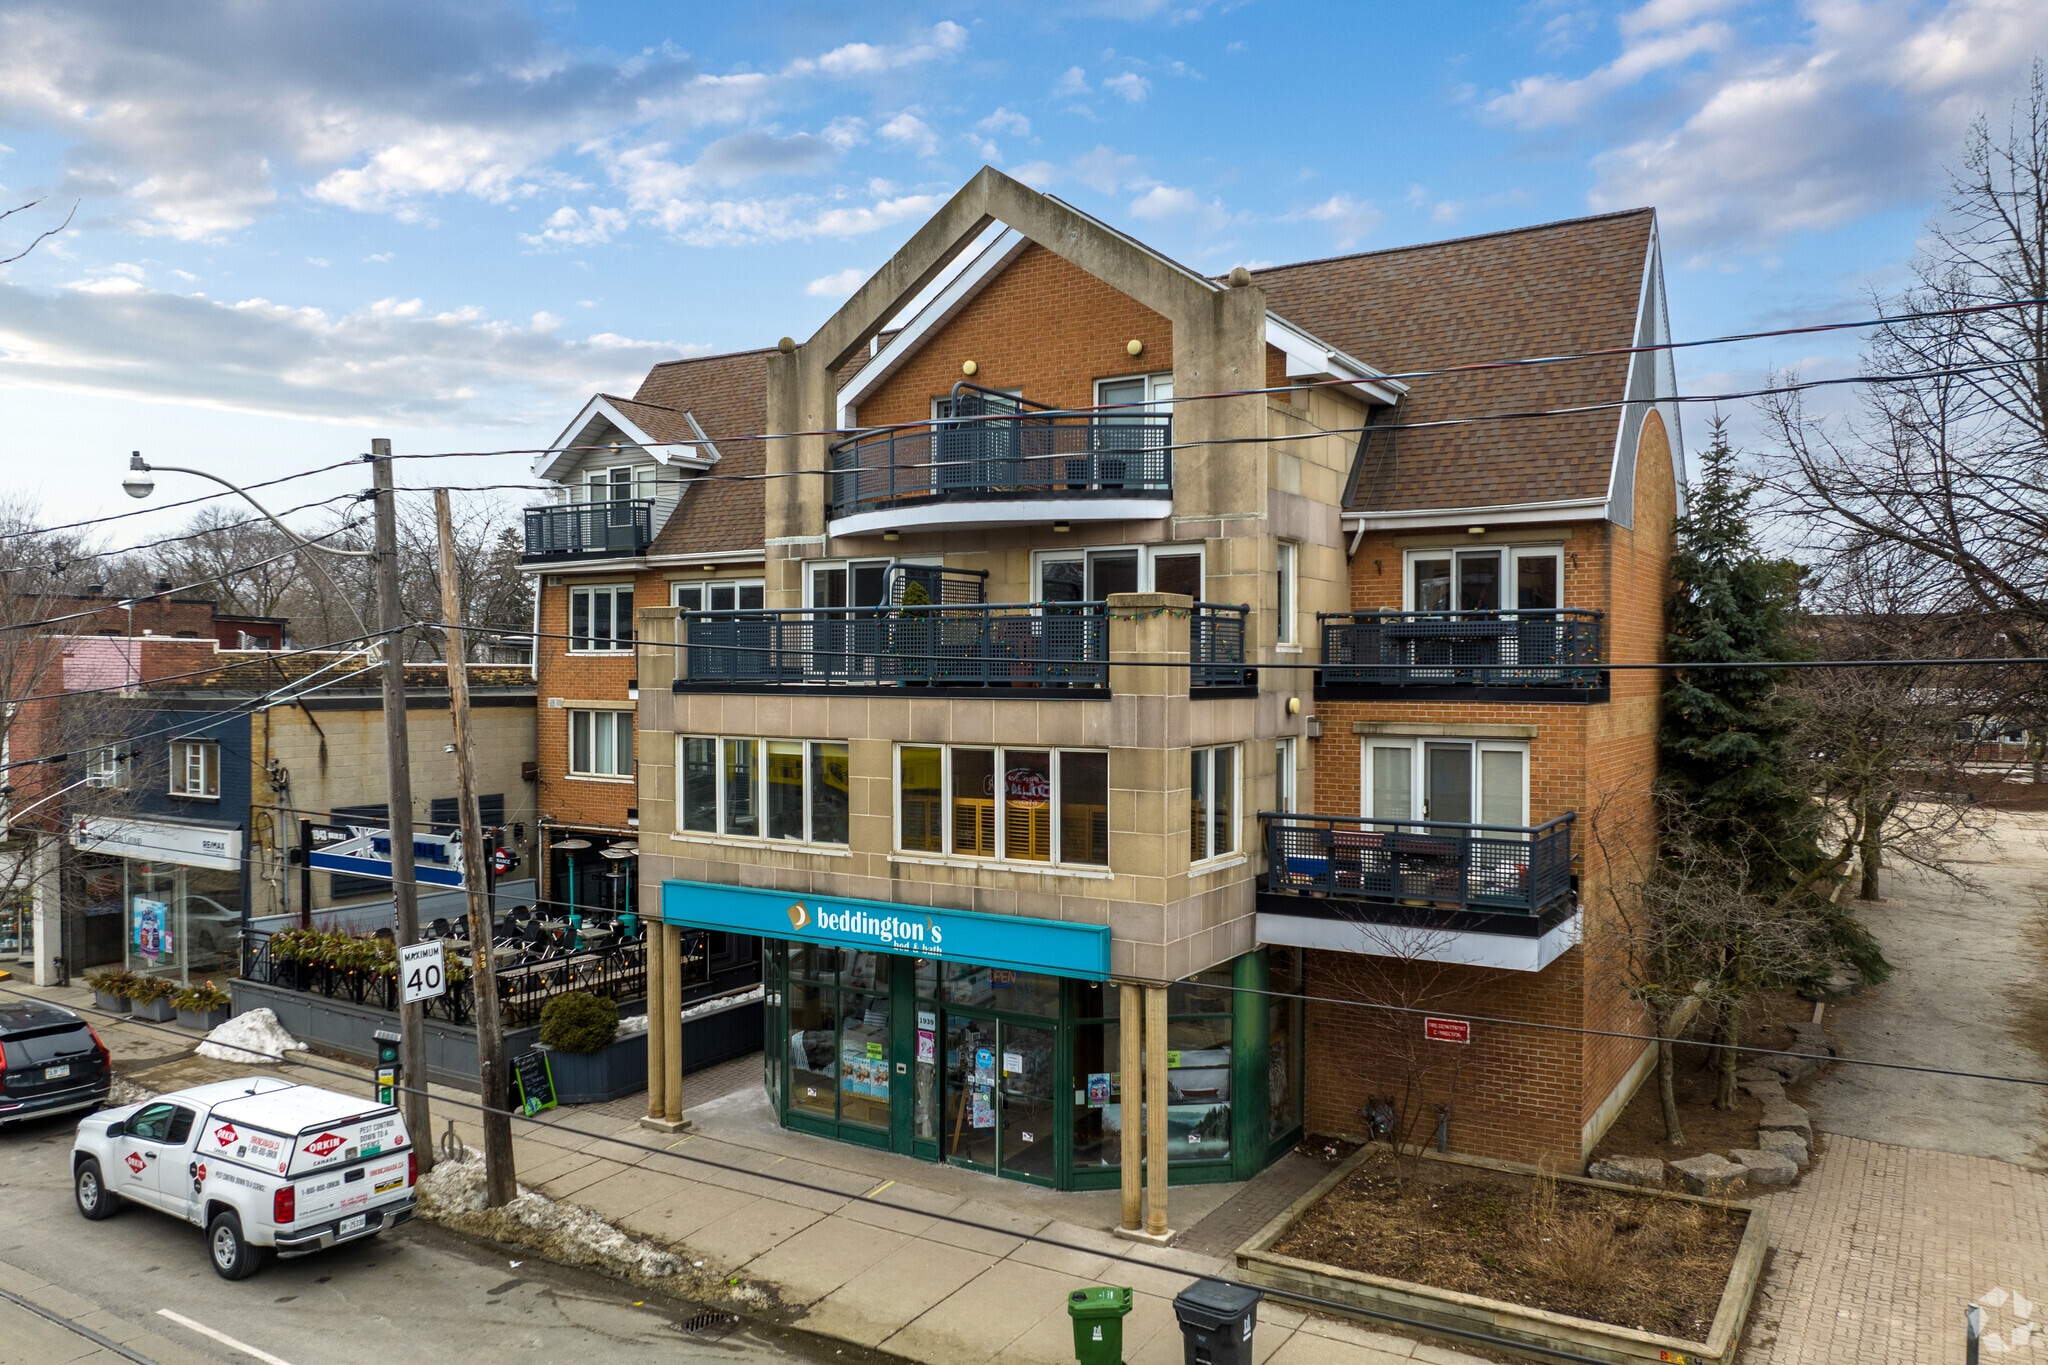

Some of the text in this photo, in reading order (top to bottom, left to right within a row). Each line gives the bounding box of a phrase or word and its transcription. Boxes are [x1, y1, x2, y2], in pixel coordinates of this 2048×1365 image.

[488, 856, 511, 865] ERANCE
[817, 906, 943, 943] beddington's
[404, 947, 440, 962] MAXIMUM
[893, 940, 943, 957] bed & bath
[406, 964, 441, 992] 40
[986, 969, 1017, 984] OPEN
[919, 1017, 934, 1026] 1939
[1438, 1023, 1467, 1031] DEPARTMENT
[360, 1120, 395, 1134] PEST CONTROL
[217, 1129, 236, 1142] ORKIN
[360, 1129, 389, 1143] DOWN TO A
[308, 1137, 340, 1153] ORKIN
[127, 1156, 144, 1169] ORKIN
[313, 1156, 337, 1166] CANADA
